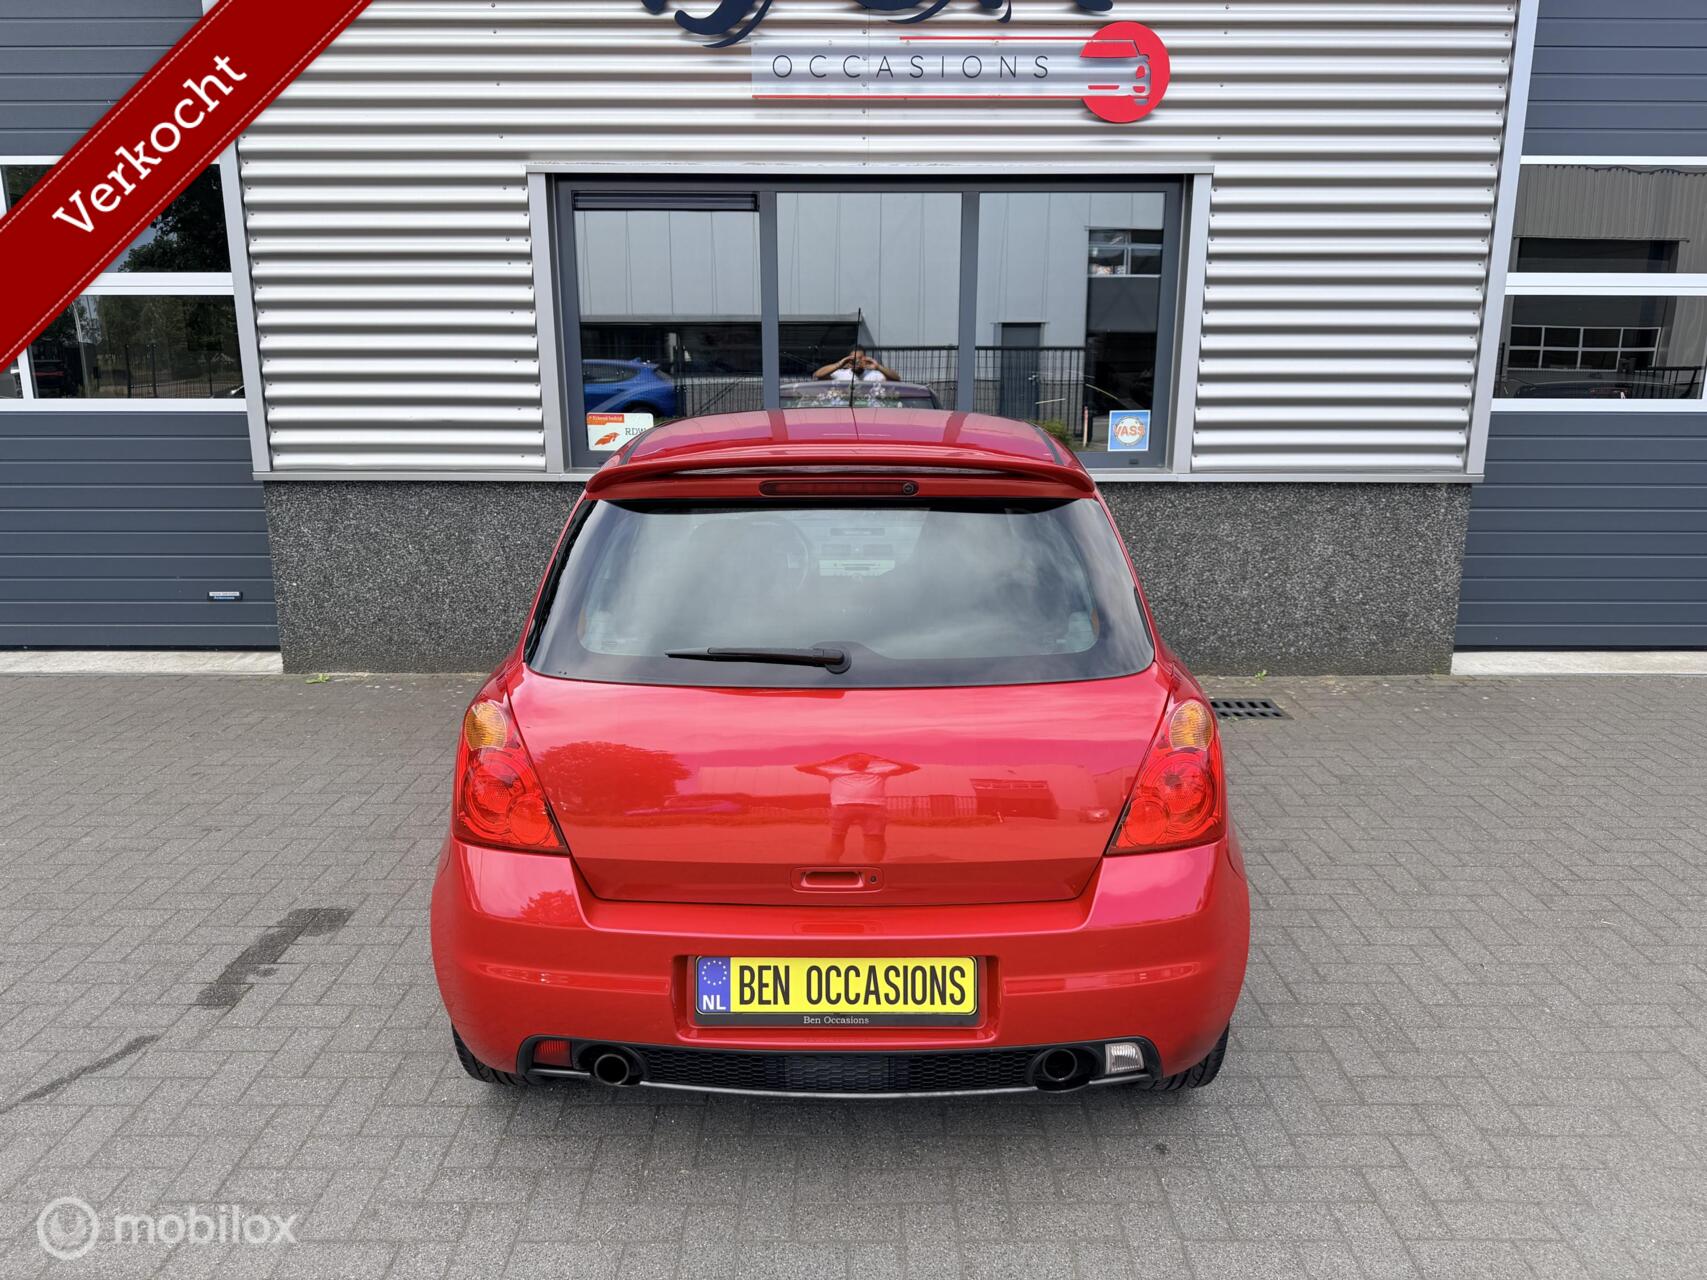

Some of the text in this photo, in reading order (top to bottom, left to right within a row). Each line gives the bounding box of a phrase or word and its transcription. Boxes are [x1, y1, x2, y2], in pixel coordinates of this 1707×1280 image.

[772, 54, 1050, 79] OCCASIONS
[739, 965, 966, 1006] BEN OCCASIONS
[702, 995, 726, 1010] NL
[803, 1015, 869, 1025] Ben Occasions
